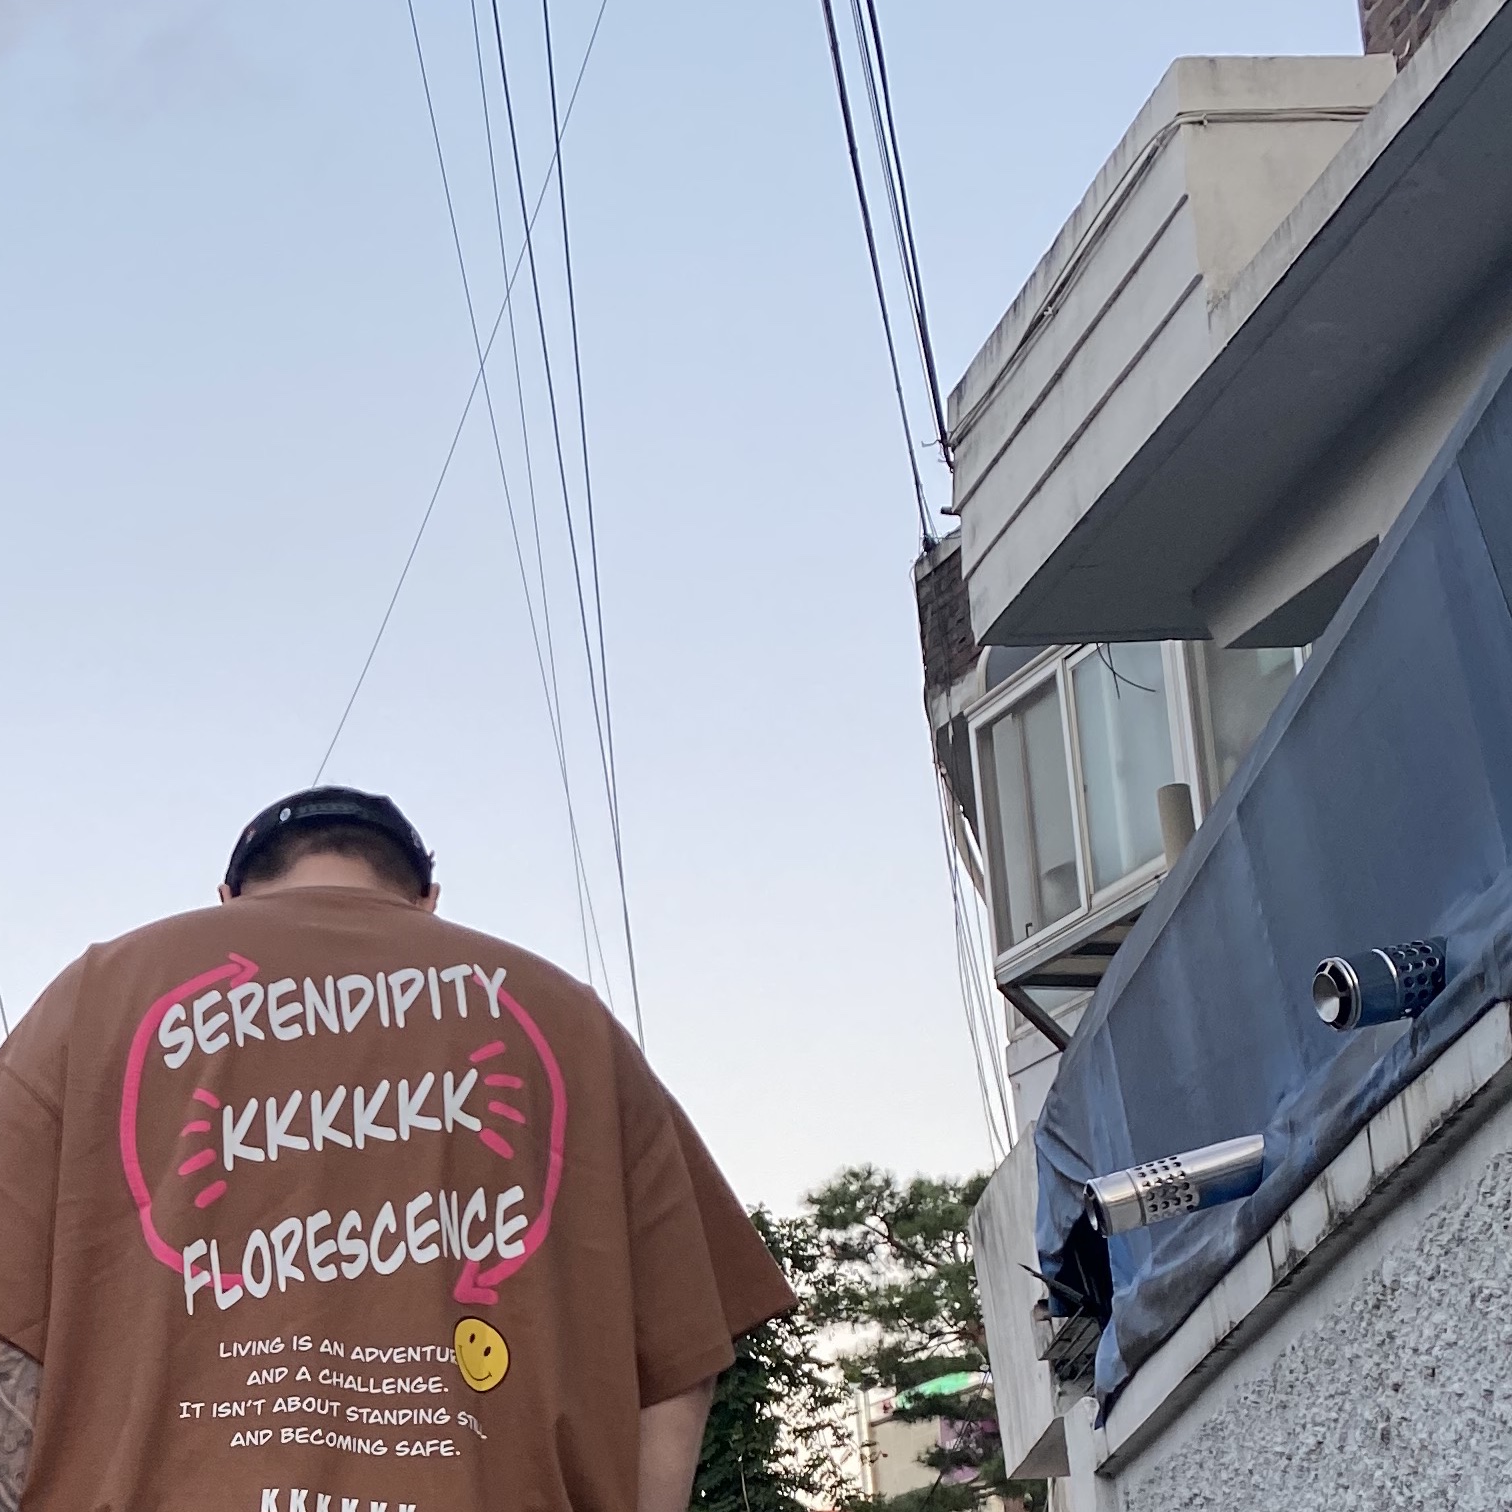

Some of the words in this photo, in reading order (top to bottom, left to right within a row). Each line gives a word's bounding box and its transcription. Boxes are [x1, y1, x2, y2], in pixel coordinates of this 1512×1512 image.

[159, 963, 506, 1069] SERENDIPITY
[222, 1068, 482, 1171] KKKKKK
[182, 1186, 528, 1315] FLORESCENCE
[219, 1337, 285, 1358] LIVING
[292, 1335, 313, 1351] IS
[319, 1339, 345, 1357] AN
[350, 1345, 458, 1365] ADVENTUR
[246, 1367, 289, 1386] AND
[295, 1366, 312, 1382] A
[318, 1369, 449, 1394] CHALLENGE.
[179, 1401, 206, 1419] IT
[212, 1398, 266, 1418] ISN'T
[272, 1396, 341, 1416] ABOUT
[345, 1407, 451, 1425] STANDING
[230, 1429, 273, 1448] AND
[280, 1427, 388, 1456] BECOMING
[395, 1439, 461, 1457] SAFE.
